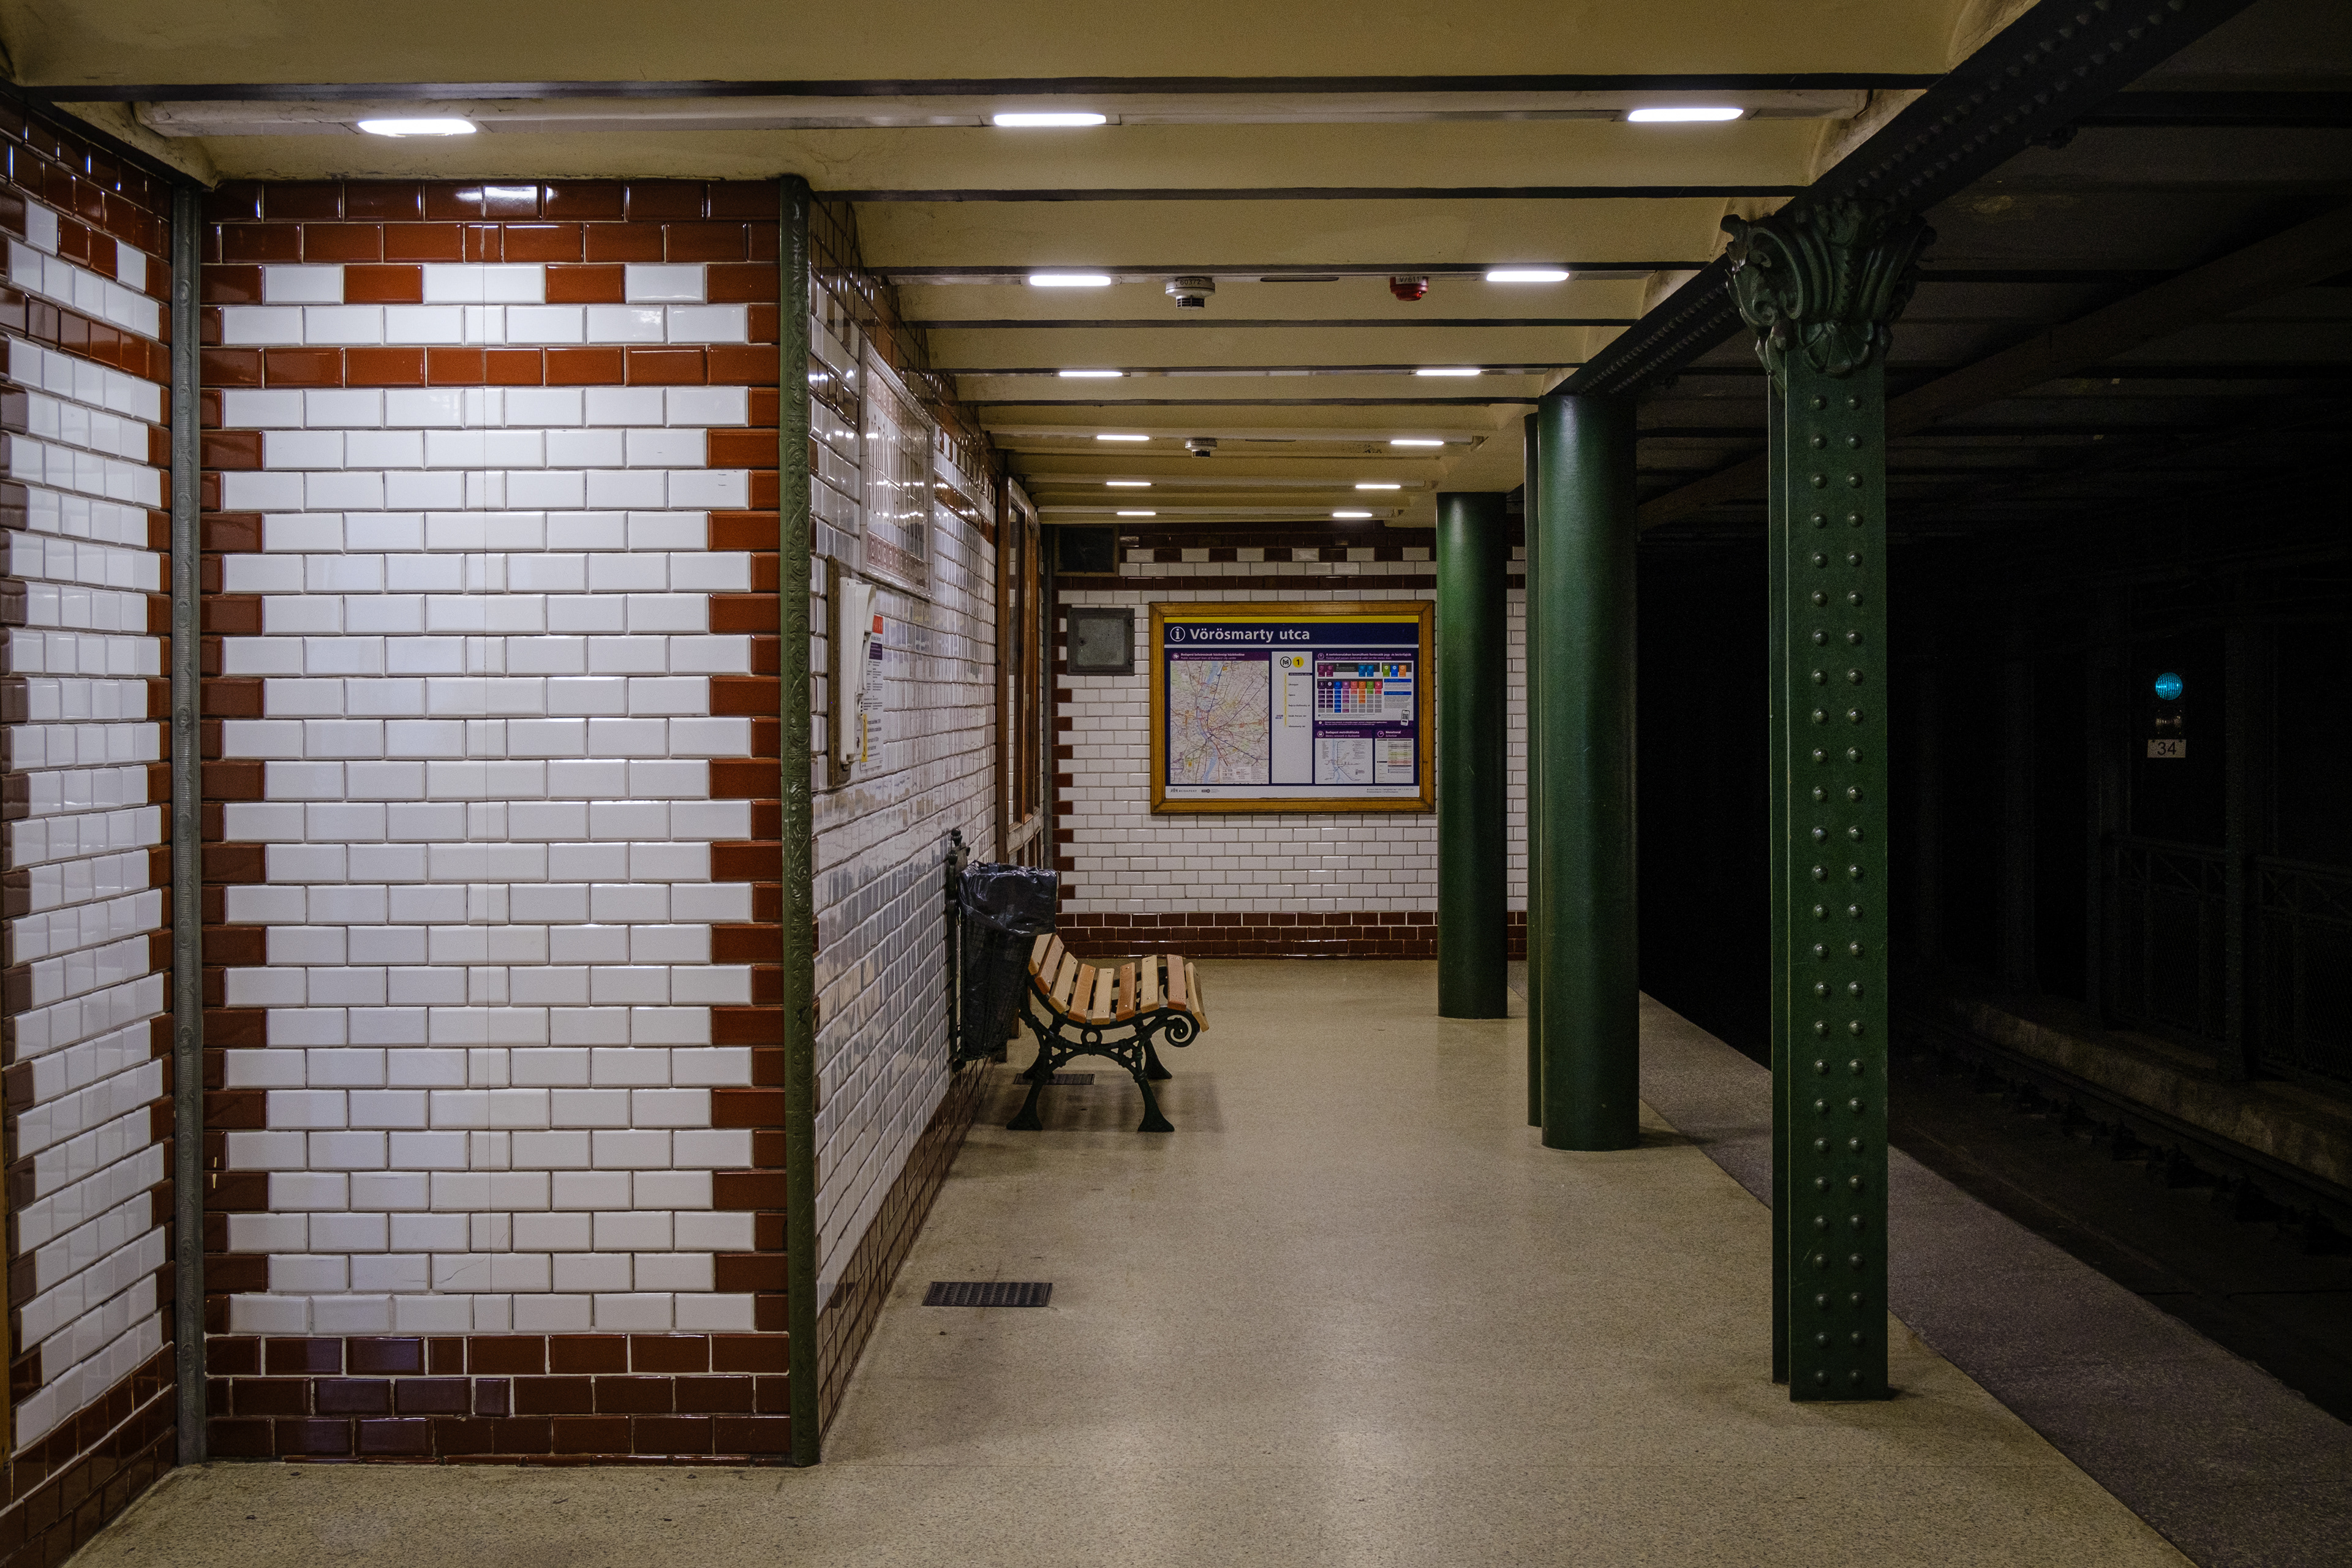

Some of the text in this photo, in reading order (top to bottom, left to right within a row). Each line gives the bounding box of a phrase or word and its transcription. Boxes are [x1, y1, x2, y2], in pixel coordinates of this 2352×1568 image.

[1189, 628, 1274, 643] Vörösmarty
[1280, 629, 1310, 640] utca
[2157, 742, 2176, 755] 34
